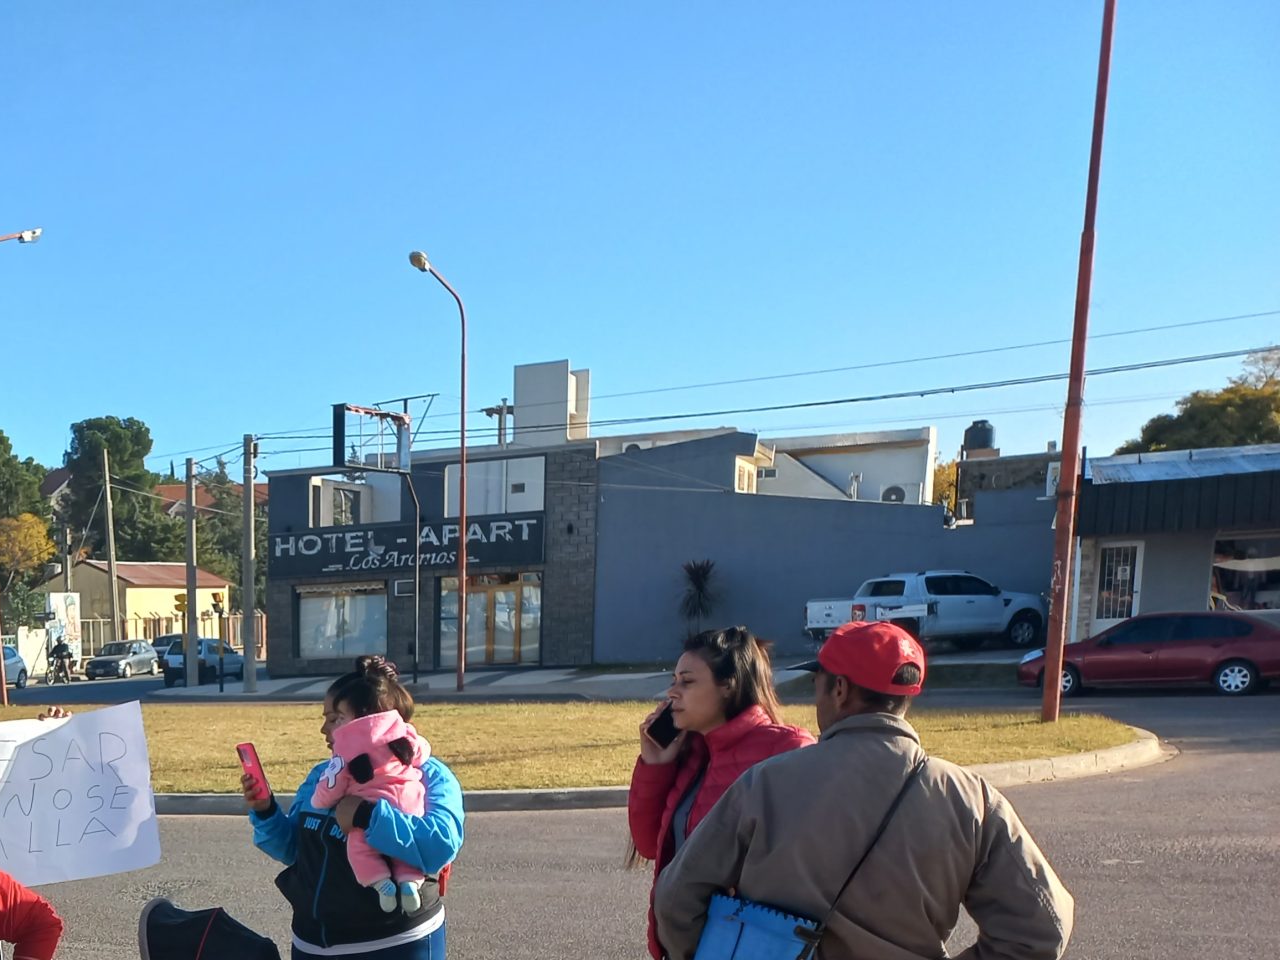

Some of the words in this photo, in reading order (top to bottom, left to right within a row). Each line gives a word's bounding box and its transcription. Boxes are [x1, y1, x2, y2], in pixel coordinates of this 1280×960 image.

[275, 531, 386, 558] HOTEL
[418, 519, 538, 547] APART
[349, 553, 381, 570] Los
[303, 816, 322, 831] JUST
